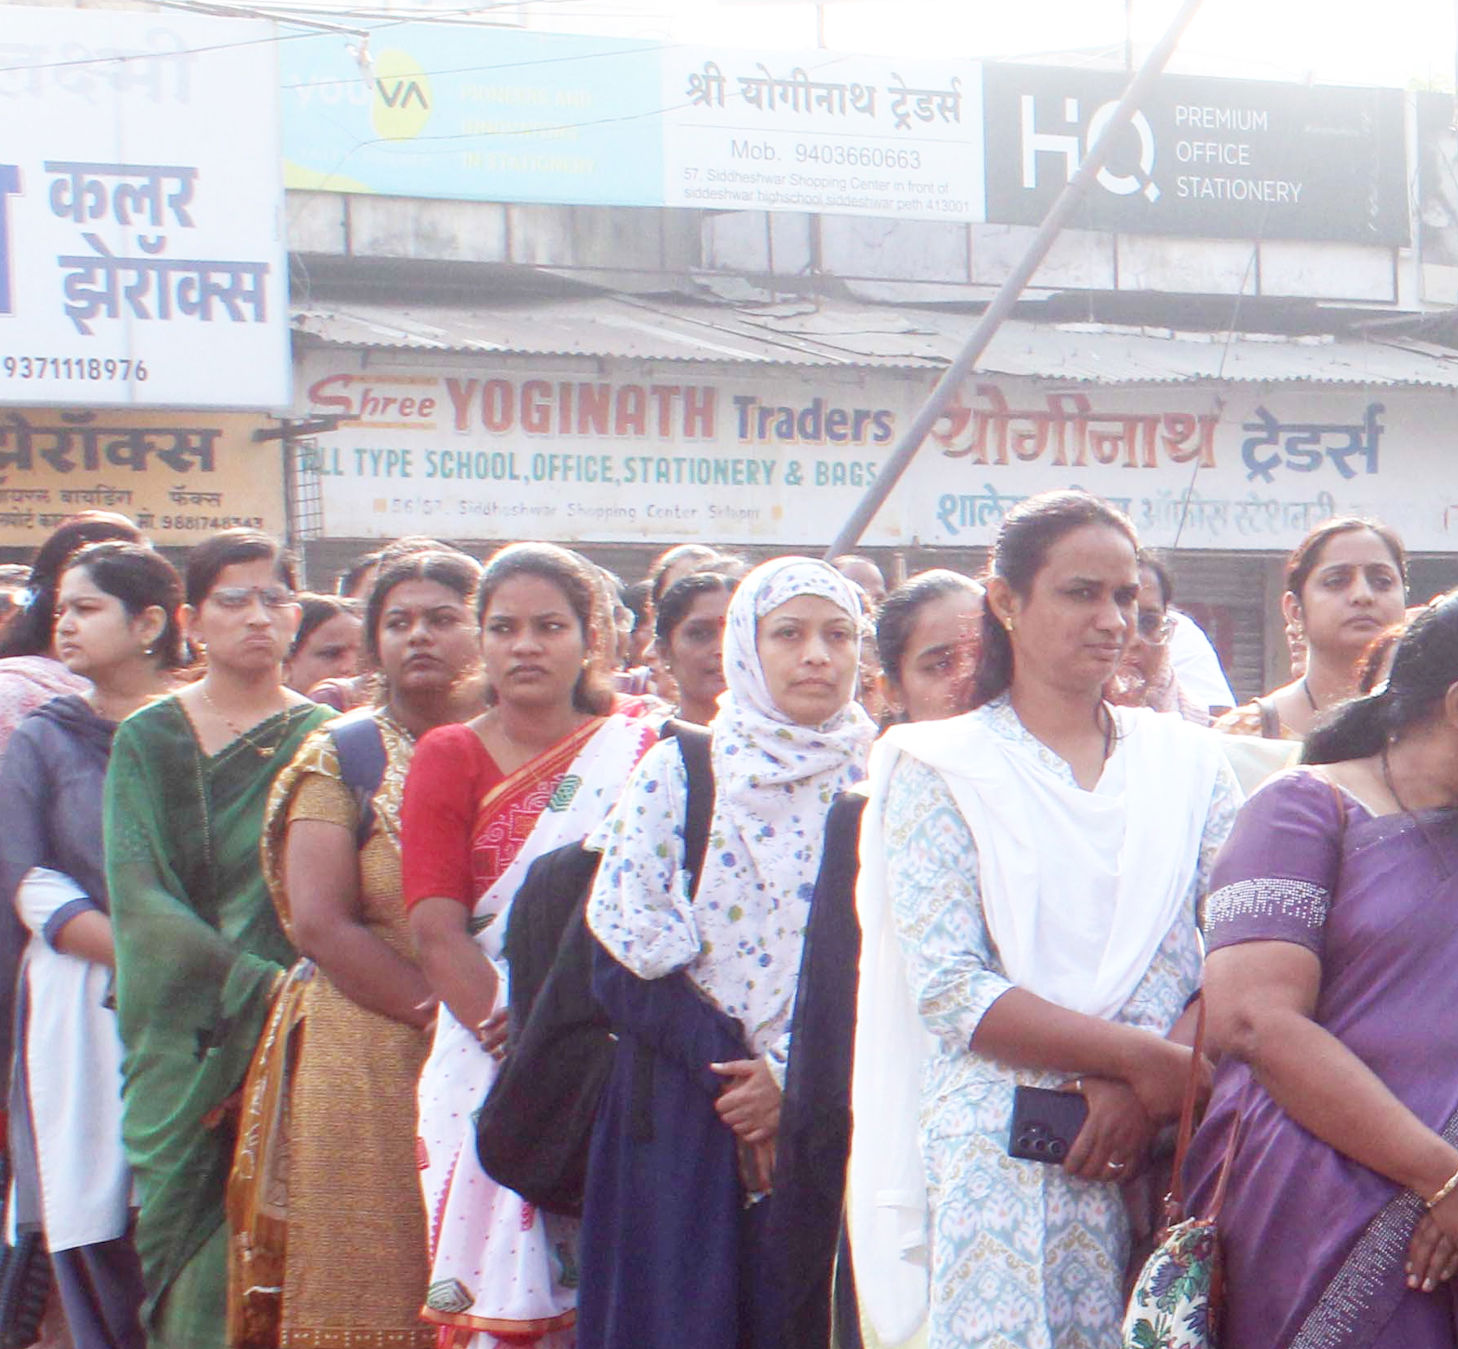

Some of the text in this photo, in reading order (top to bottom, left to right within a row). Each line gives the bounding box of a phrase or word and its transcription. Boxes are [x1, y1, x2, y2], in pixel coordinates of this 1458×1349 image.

[686, 61, 962, 130] श्री योगीनाथ ट्रेडर्स
[1175, 105, 1269, 132] PREMIUM
[731, 139, 922, 170] Mob. 9403660663
[1175, 140, 1251, 166] OFFICE
[44, 160, 200, 229] कलर
[790, 173, 848, 191] Shopping
[850, 176, 890, 191] Center
[907, 181, 938, 194] front
[940, 182, 950, 195] of
[1176, 175, 1303, 204] STATIONERY
[897, 197, 923, 212] peth
[57, 232, 270, 335] झेरॉक्स
[4, 356, 149, 382] 9371118976
[308, 373, 895, 446] Shree YOGINATH Traders
[1241, 402, 1386, 484] ट्रेडर्स
[355, 449, 412, 478] TYPE
[785, 460, 804, 487] &
[815, 460, 878, 487] BAGS
